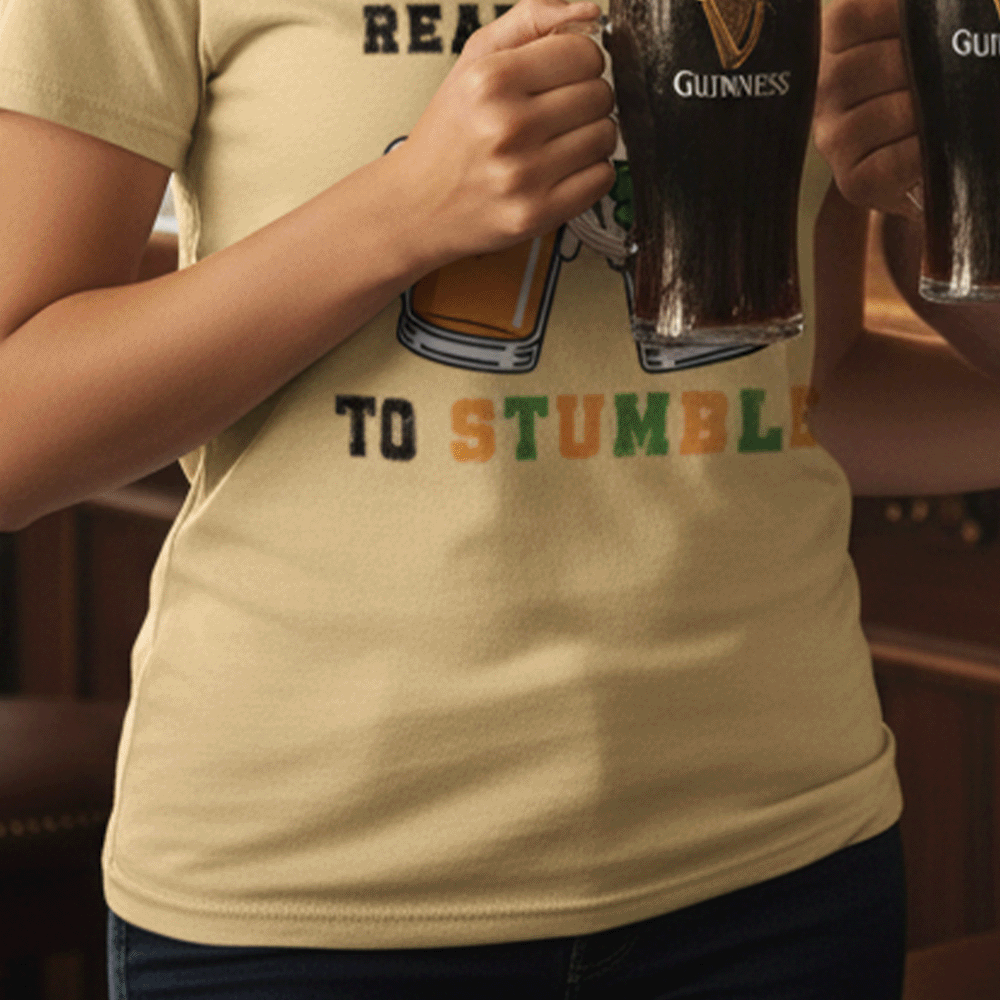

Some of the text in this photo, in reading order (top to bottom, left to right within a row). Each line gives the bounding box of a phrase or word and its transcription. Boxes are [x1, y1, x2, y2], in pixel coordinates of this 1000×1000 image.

[363, 3, 514, 54] REA
[673, 69, 791, 98] GUINNESS
[335, 394, 416, 461] TO
